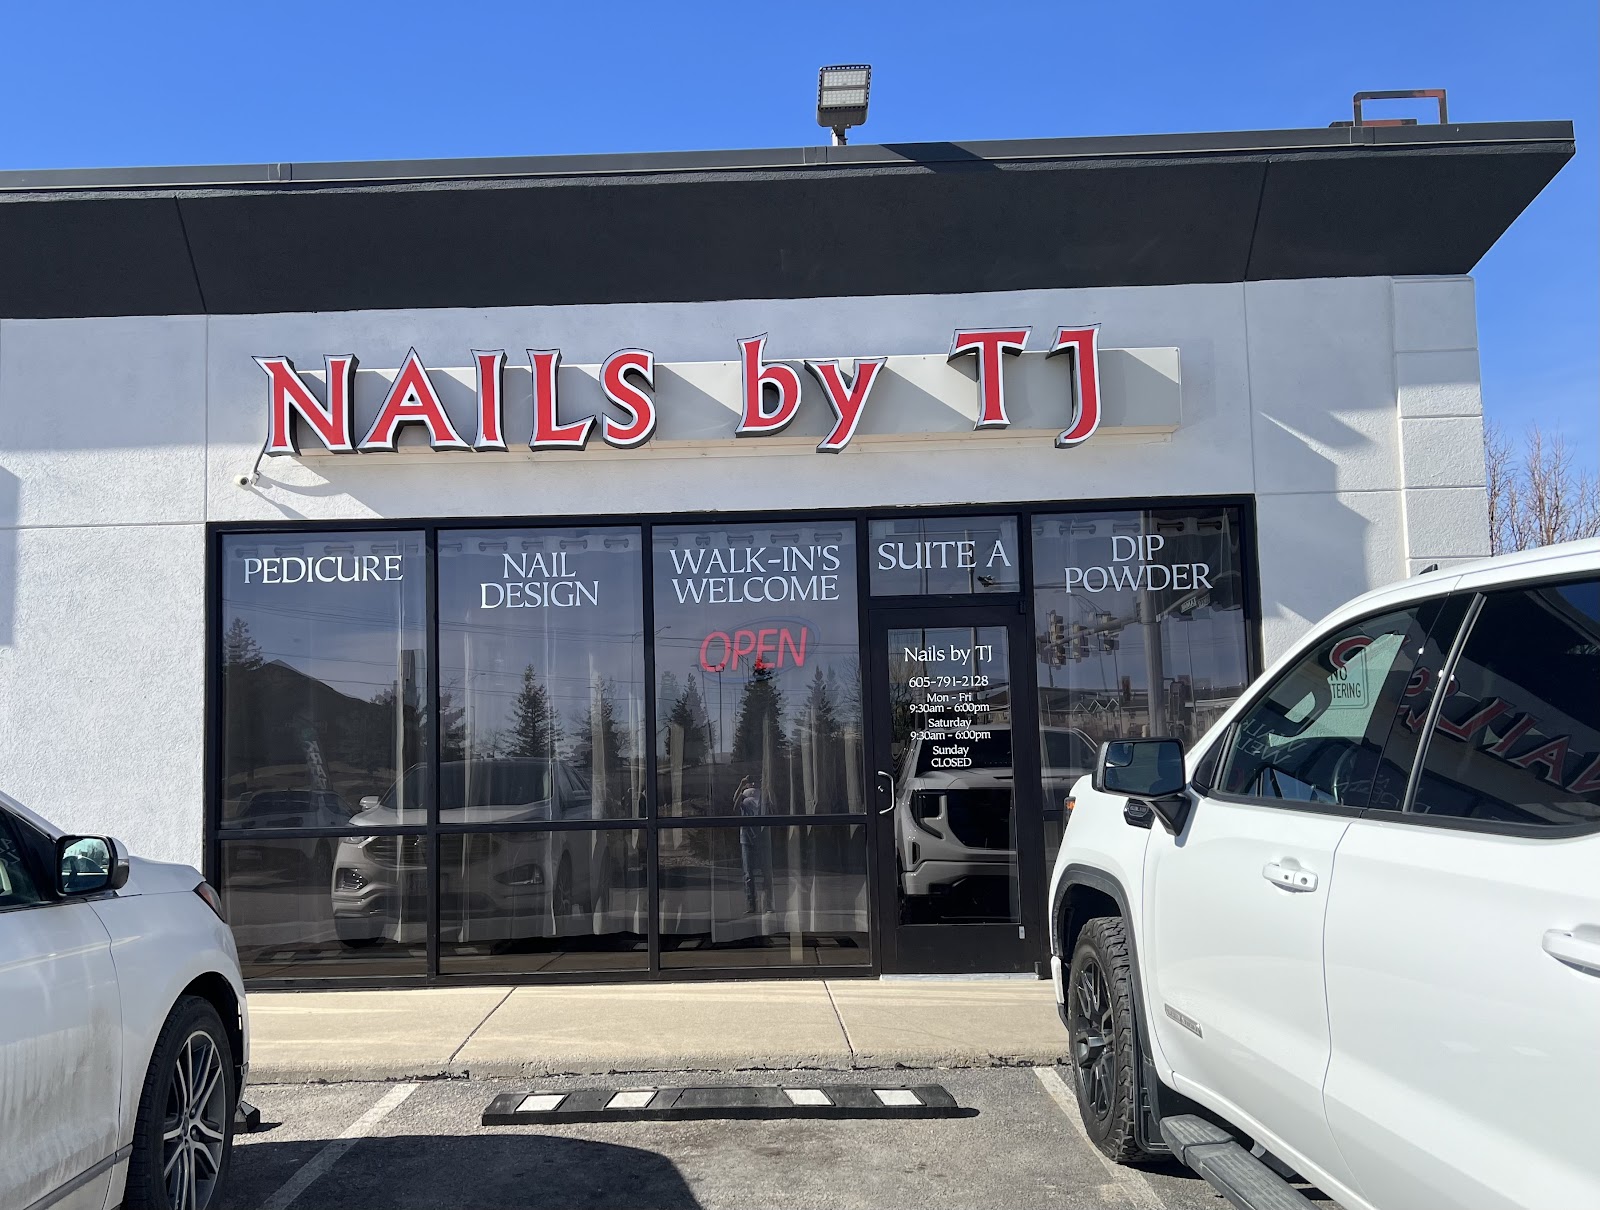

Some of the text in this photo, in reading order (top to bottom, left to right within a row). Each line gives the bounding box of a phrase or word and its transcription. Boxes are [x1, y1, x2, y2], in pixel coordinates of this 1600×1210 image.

[252, 323, 1102, 456] NAILS by TJ
[670, 545, 840, 574] WALK-IN'S
[878, 539, 1012, 571] SUITE A
[1111, 534, 1165, 563] DIP
[244, 554, 404, 584] PEDICURE
[502, 551, 577, 579] NAIL
[1064, 562, 1214, 594] POWDER
[480, 580, 599, 609] DESIGN
[671, 574, 840, 604] WELCOME
[698, 626, 808, 673] OPEN
[903, 644, 993, 666] Nails by TJ
[908, 675, 989, 688] 605-791-2128
[1331, 682, 1362, 699] TERING
[909, 703, 945, 714] 9:30am
[954, 702, 991, 715] 6:00pm
[926, 692, 949, 703] Mon
[959, 692, 972, 702] Fri
[910, 731, 946, 742] 9:30am
[955, 730, 992, 743] 6:00pm
[928, 717, 972, 730] Saturday
[931, 757, 973, 769] CLOSED
[932, 744, 970, 758] Sunday
